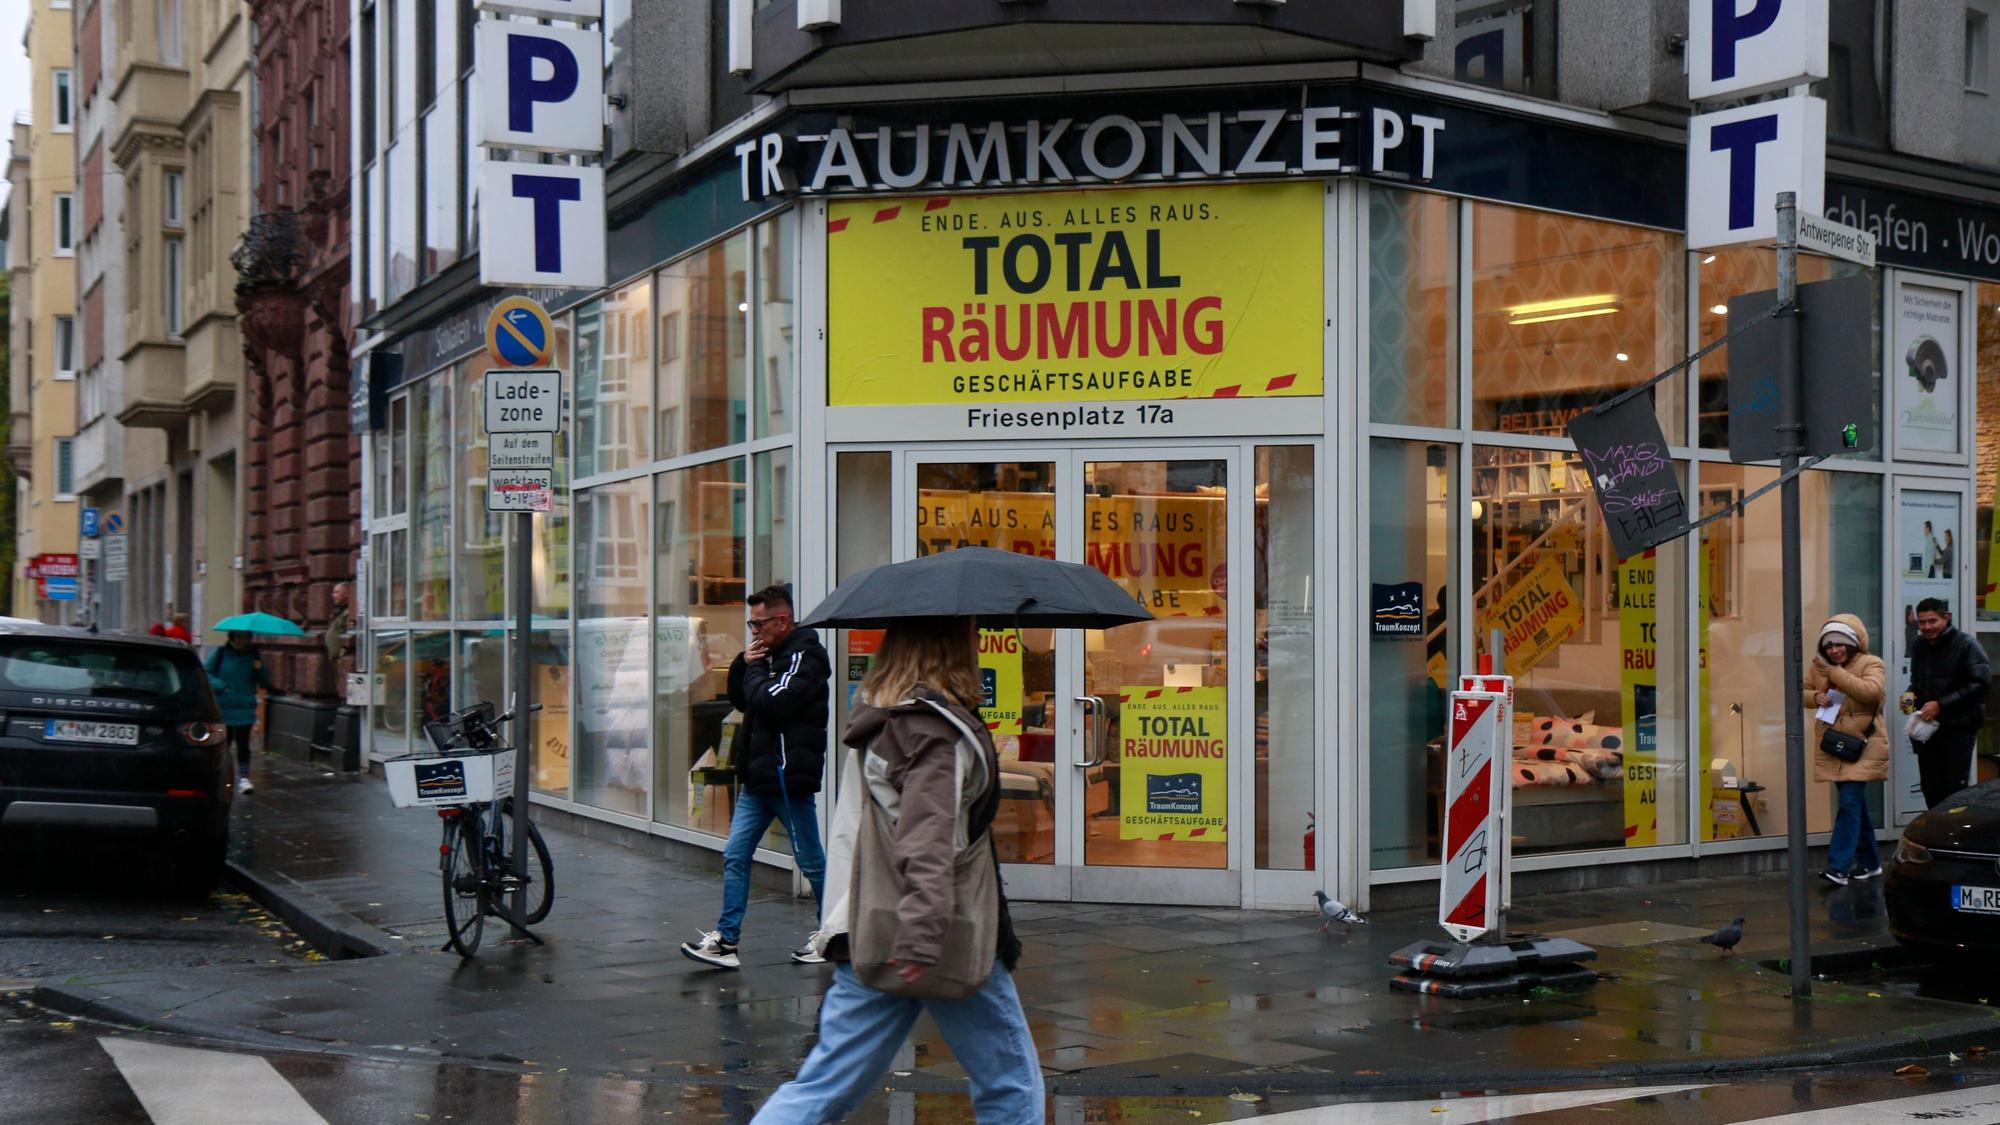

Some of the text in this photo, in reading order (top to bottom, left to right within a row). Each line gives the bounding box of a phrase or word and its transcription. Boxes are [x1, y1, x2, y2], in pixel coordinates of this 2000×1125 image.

[736, 105, 1445, 202] TRAUMKONZEPT
[922, 203, 1219, 232] ENDE. AUS. ALLES RAUS.
[1824, 195, 1928, 254] chlafen
[1800, 216, 1872, 256] Antwerpener Str.
[963, 229, 1181, 295] TOTAL
[922, 296, 1225, 363] RäUMUNG
[495, 381, 550, 400] Lade-
[953, 369, 1192, 393] GESCHÄFTSAUFGABE
[500, 407, 543, 422] zone
[968, 405, 1174, 430] Friesenplatz 17a
[504, 438, 539, 448] Auf dem
[492, 454, 552, 465] Seitenstreifen
[971, 508, 1027, 528] AUS.
[1134, 512, 1203, 532] RAUS.
[1629, 569, 1656, 585] END
[1498, 583, 1551, 630] TOTAL
[1623, 593, 1656, 608] ALLE
[1375, 622, 1420, 634] TraumKonzept
[1504, 590, 1569, 656] RäUMUNG
[31, 697, 157, 710] DISCOVERY
[55, 724, 65, 736] K
[75, 725, 96, 737] NM
[100, 725, 135, 739] 2803
[1138, 716, 1210, 737] TOTAL
[1125, 738, 1224, 759] RäUMUNG
[1150, 801, 1199, 811] TraumKonzept
[1125, 815, 1224, 826] GESCHÄFTSAUFGABE
[1961, 888, 1972, 906] M
